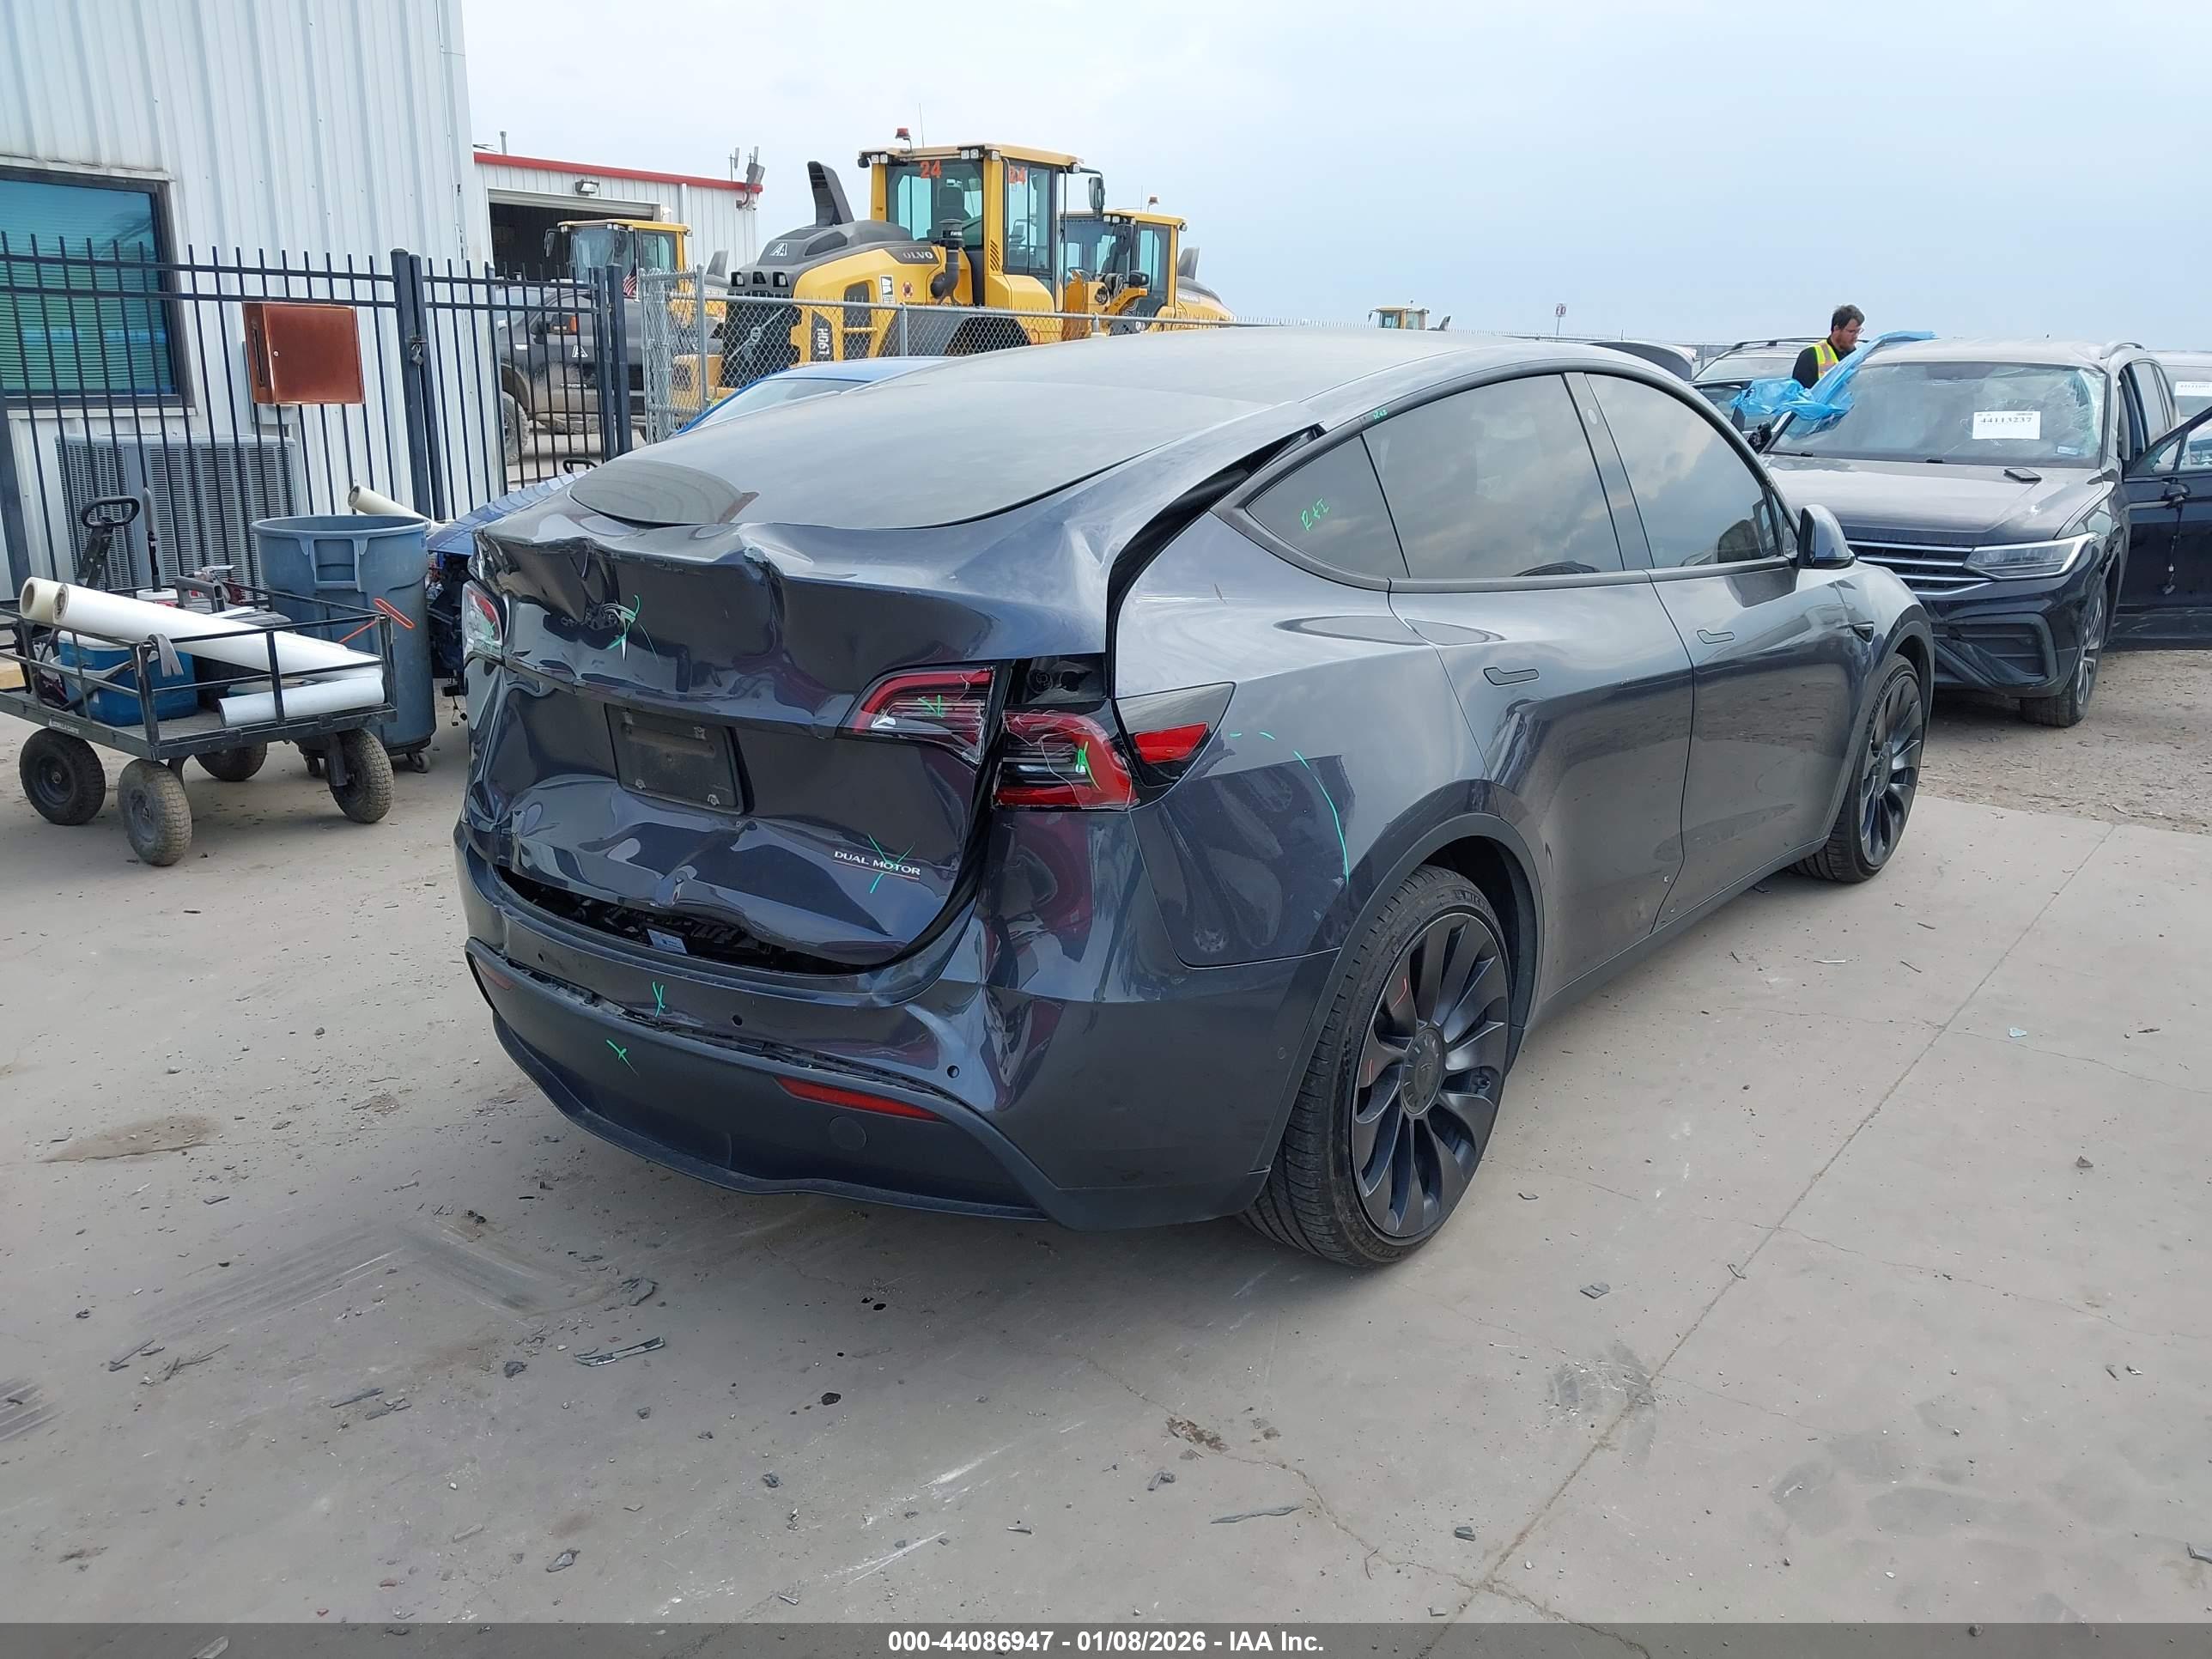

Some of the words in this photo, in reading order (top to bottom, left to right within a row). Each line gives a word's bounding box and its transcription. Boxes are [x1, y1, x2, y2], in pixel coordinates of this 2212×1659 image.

[921, 159, 942, 179] 24
[834, 851, 869, 866] DUAL
[872, 860, 921, 876] MOTOR
